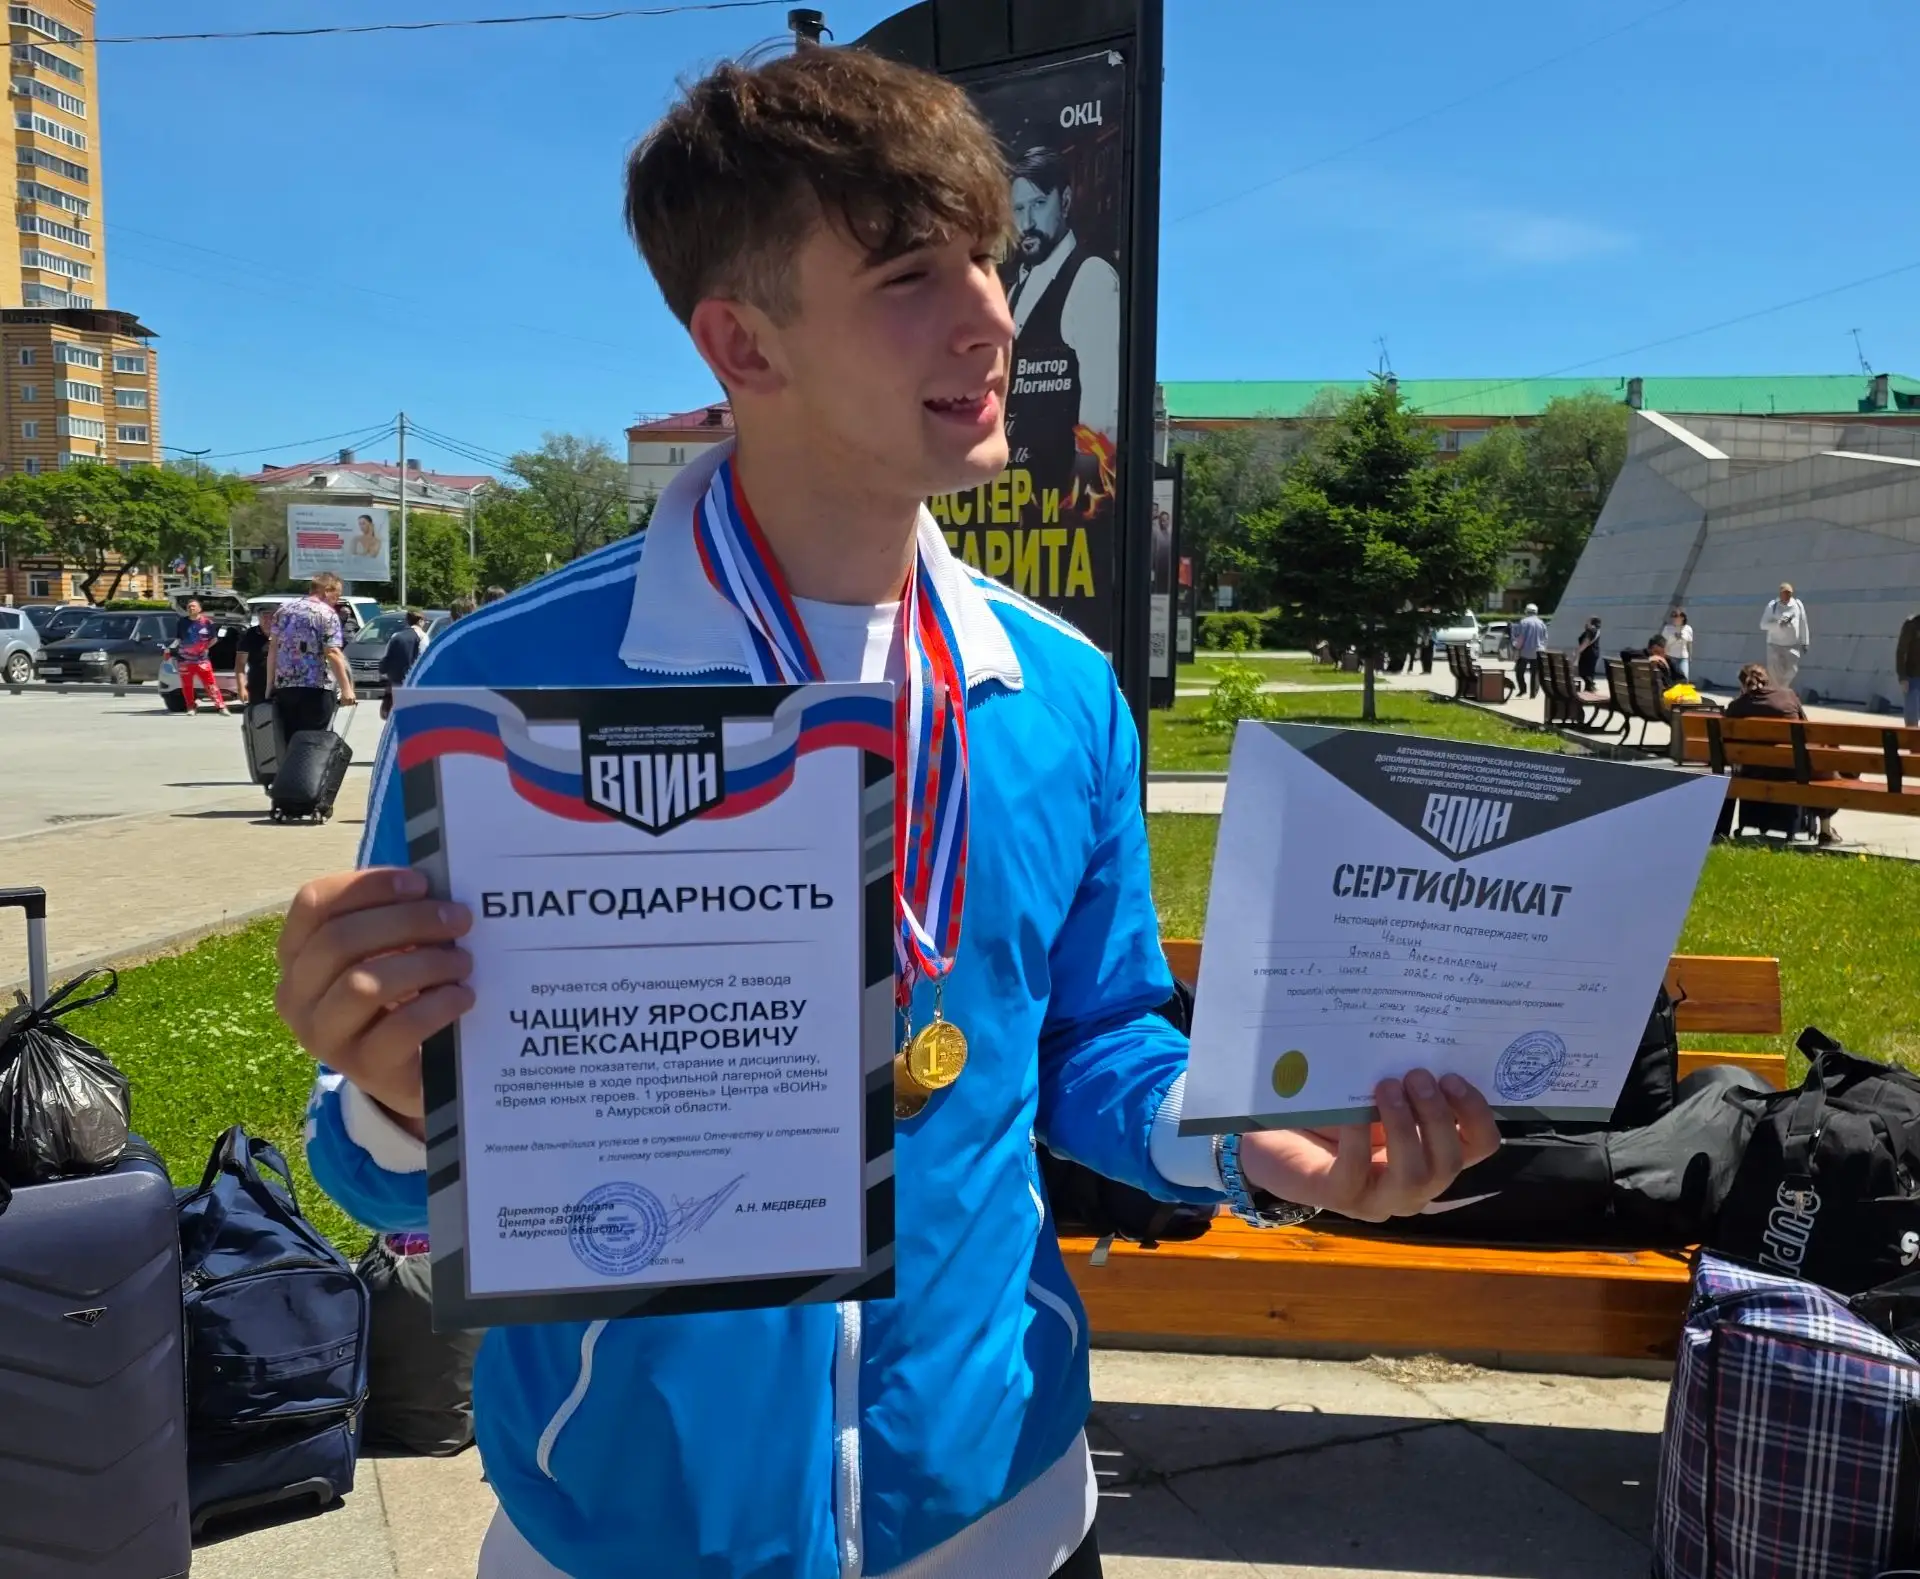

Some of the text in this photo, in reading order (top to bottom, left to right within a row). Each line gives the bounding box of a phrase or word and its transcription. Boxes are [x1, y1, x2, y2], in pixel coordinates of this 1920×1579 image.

[1060, 100, 1103, 128] ОКЦ
[1016, 359, 1069, 375] Виктор
[1011, 378, 1072, 395] Логинов
[926, 469, 1033, 526] АСТЕР
[1375, 754, 1582, 786] ДОПОЛНИТЕЛЬНОГО ПРОФЕССИОНАЛЬНОГО ОБРАЗОВАНИЯ
[1396, 747, 1566, 775] АВТОНОМНАЯ НЕКОММЕРЧЕСКАЯ ОРГАНИЗАЦИЯ
[589, 753, 718, 828] ВОИН
[1396, 776, 1465, 790] ПАТРИОТИЧЕСКОГО
[1465, 784, 1513, 796] ВОСПИТАНИЯ
[1407, 767, 1444, 779] РАЗВИТИЯ
[1444, 771, 1524, 788] ВОЕННО-СПОРТИВНОЙ
[1524, 781, 1573, 795] ПОДГОТОВКИ
[1421, 792, 1513, 855] ВОИН
[481, 884, 835, 920] БЛАГОДАРНОСТЬ
[1332, 863, 1573, 918] СЕРТИФИКАТ
[1333, 913, 1549, 943] Настоящий сертификат подтверждает, что
[531, 973, 791, 997] вручается обучающемуся 2 взвода
[1253, 967, 1259, 976] в
[1260, 968, 1289, 977] период
[1290, 968, 1297, 976] с
[1443, 974, 1456, 985] по
[1325, 986, 1360, 997] обучение
[1371, 988, 1443, 1000] дополнительной
[509, 998, 808, 1033] ЧАЩИНУ ЯРОСЛАВУ
[520, 1025, 800, 1058] АЛЕКСАНДРОВИЧУ
[501, 1053, 820, 1078] за высокие показатели, старание и дисциплину,
[924, 1036, 943, 1077] 1
[494, 1067, 828, 1095] проявленные в ходе профильной лагерной смены
[495, 1080, 829, 1110] «Время юных героев. 1 уровень» Центра «ВОИН»
[595, 1101, 733, 1119] в Амурской области.
[484, 1126, 840, 1154] Желаем дальнейших успехов в служении Отечеству и стремлении
[599, 1155, 605, 1163] к
[606, 1151, 652, 1164] личному
[497, 1202, 615, 1219] Директор филиала
[735, 1197, 827, 1215] А.Н. МЕДВЕДЕВ
[498, 1217, 546, 1230] Центра
[498, 1231, 506, 1240] в
[509, 1226, 568, 1241] Амурской
